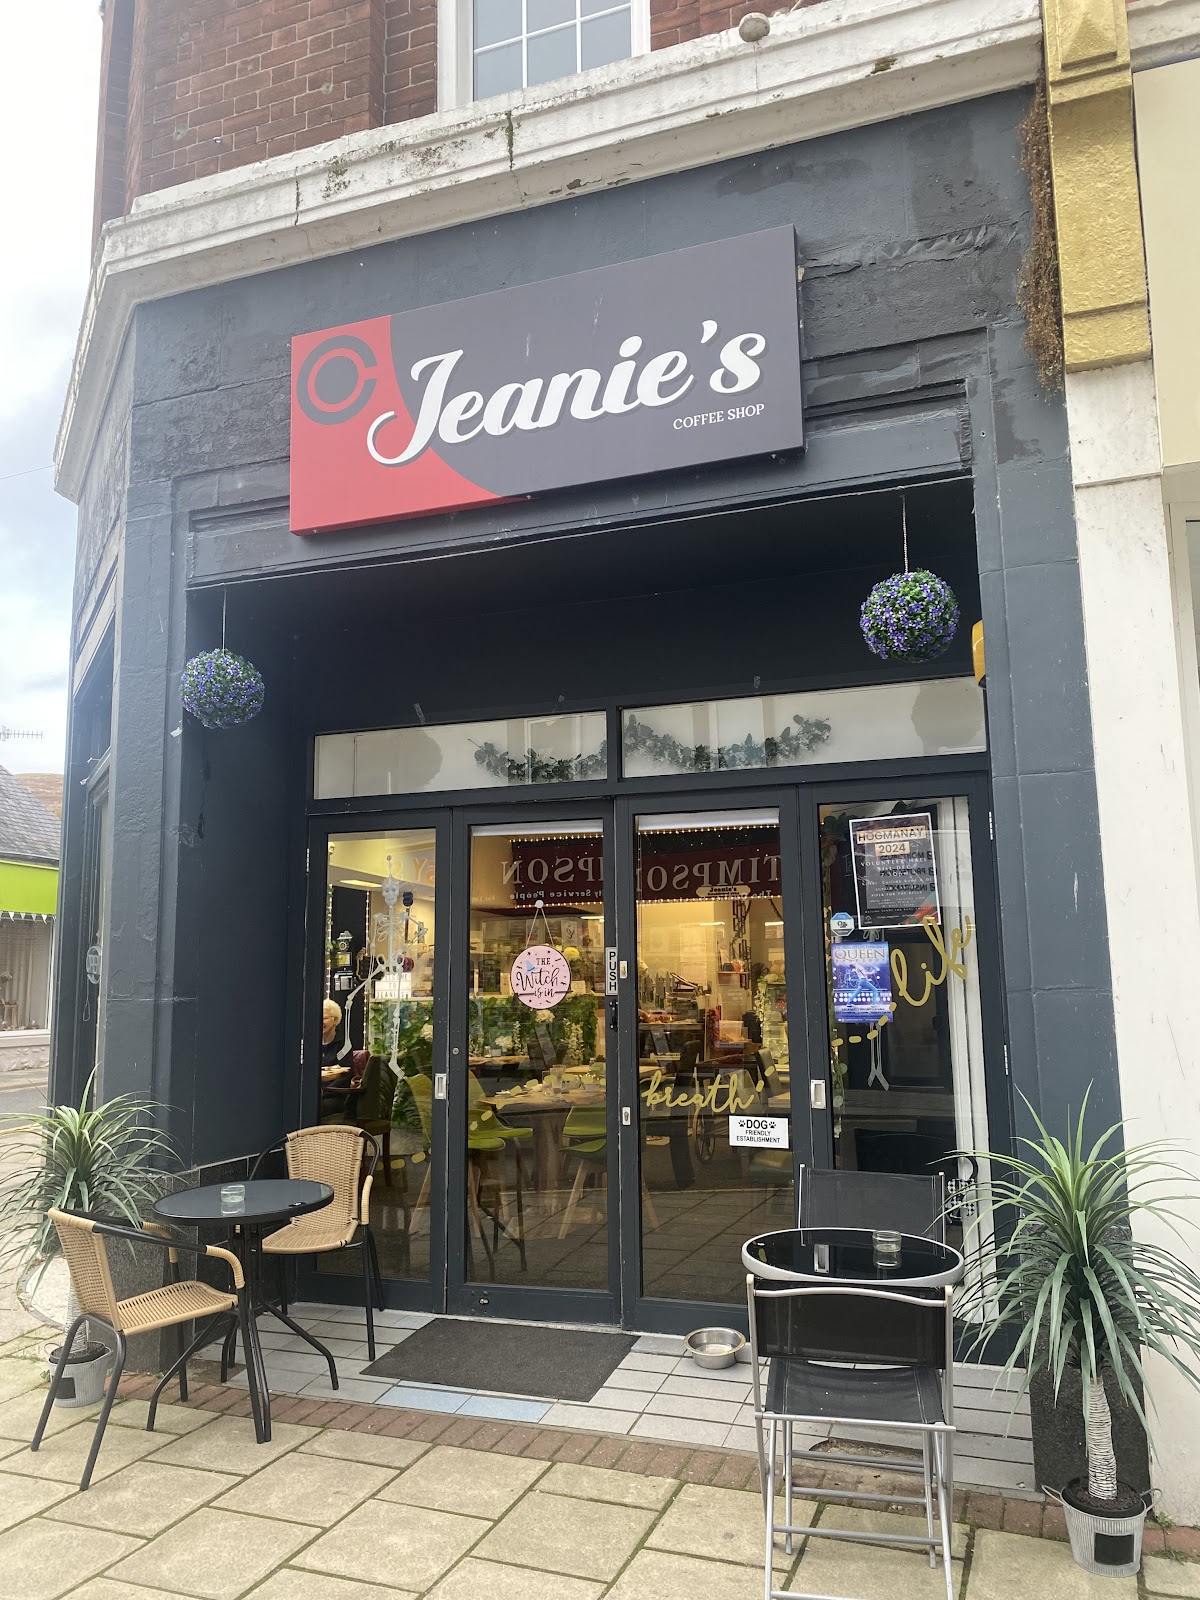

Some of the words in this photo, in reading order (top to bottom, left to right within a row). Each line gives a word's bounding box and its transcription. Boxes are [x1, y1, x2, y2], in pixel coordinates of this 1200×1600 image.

[366, 319, 766, 465] Jeanie's
[672, 410, 725, 430] COFFEE
[727, 403, 765, 421] SHOP
[858, 827, 924, 842] HOGMANAY
[878, 843, 907, 854] 2024
[536, 957, 551, 966] THE
[834, 949, 886, 961] QUEEN
[890, 915, 971, 1007] life
[609, 951, 617, 991] PUSH
[515, 967, 560, 992] Witch
[534, 987, 543, 998] is
[544, 987, 556, 998] in
[640, 1069, 755, 1114] breath
[746, 1119, 768, 1130] DOG
[736, 1135, 781, 1144] ESTABLISHMENT
[745, 1129, 772, 1137] FRIENDLY
